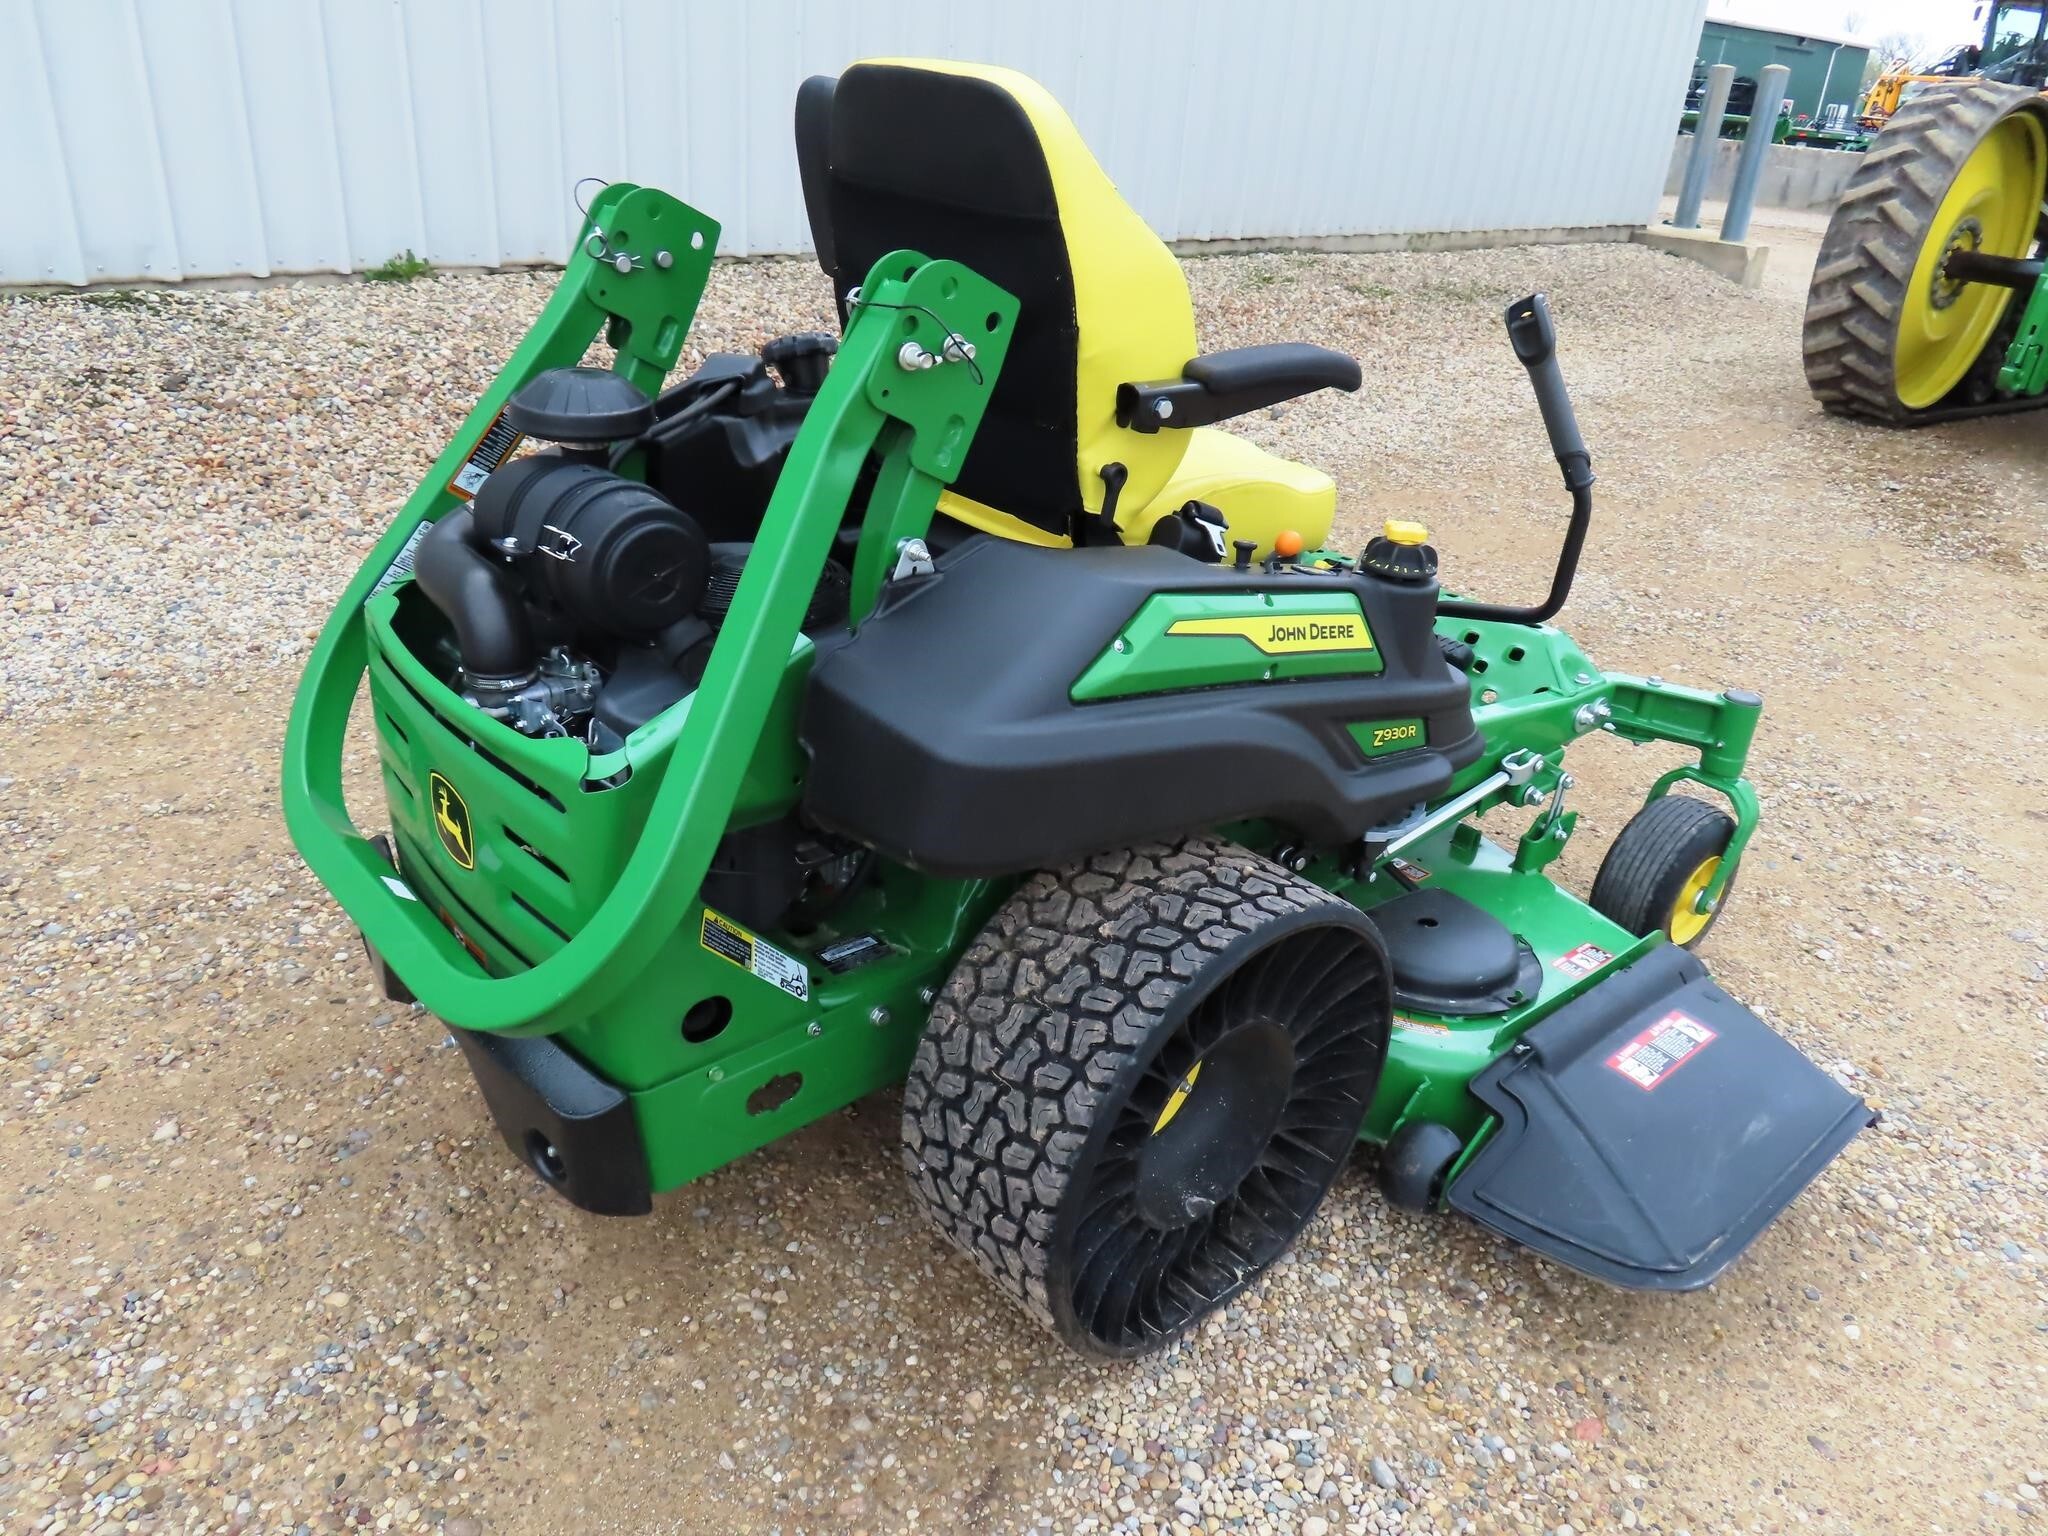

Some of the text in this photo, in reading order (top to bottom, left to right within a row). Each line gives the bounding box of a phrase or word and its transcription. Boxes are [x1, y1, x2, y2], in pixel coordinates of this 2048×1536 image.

[1268, 623, 1354, 642] JOHN DEERE
[1373, 725, 1416, 747] Z930R
[718, 919, 743, 938] CAUTION
